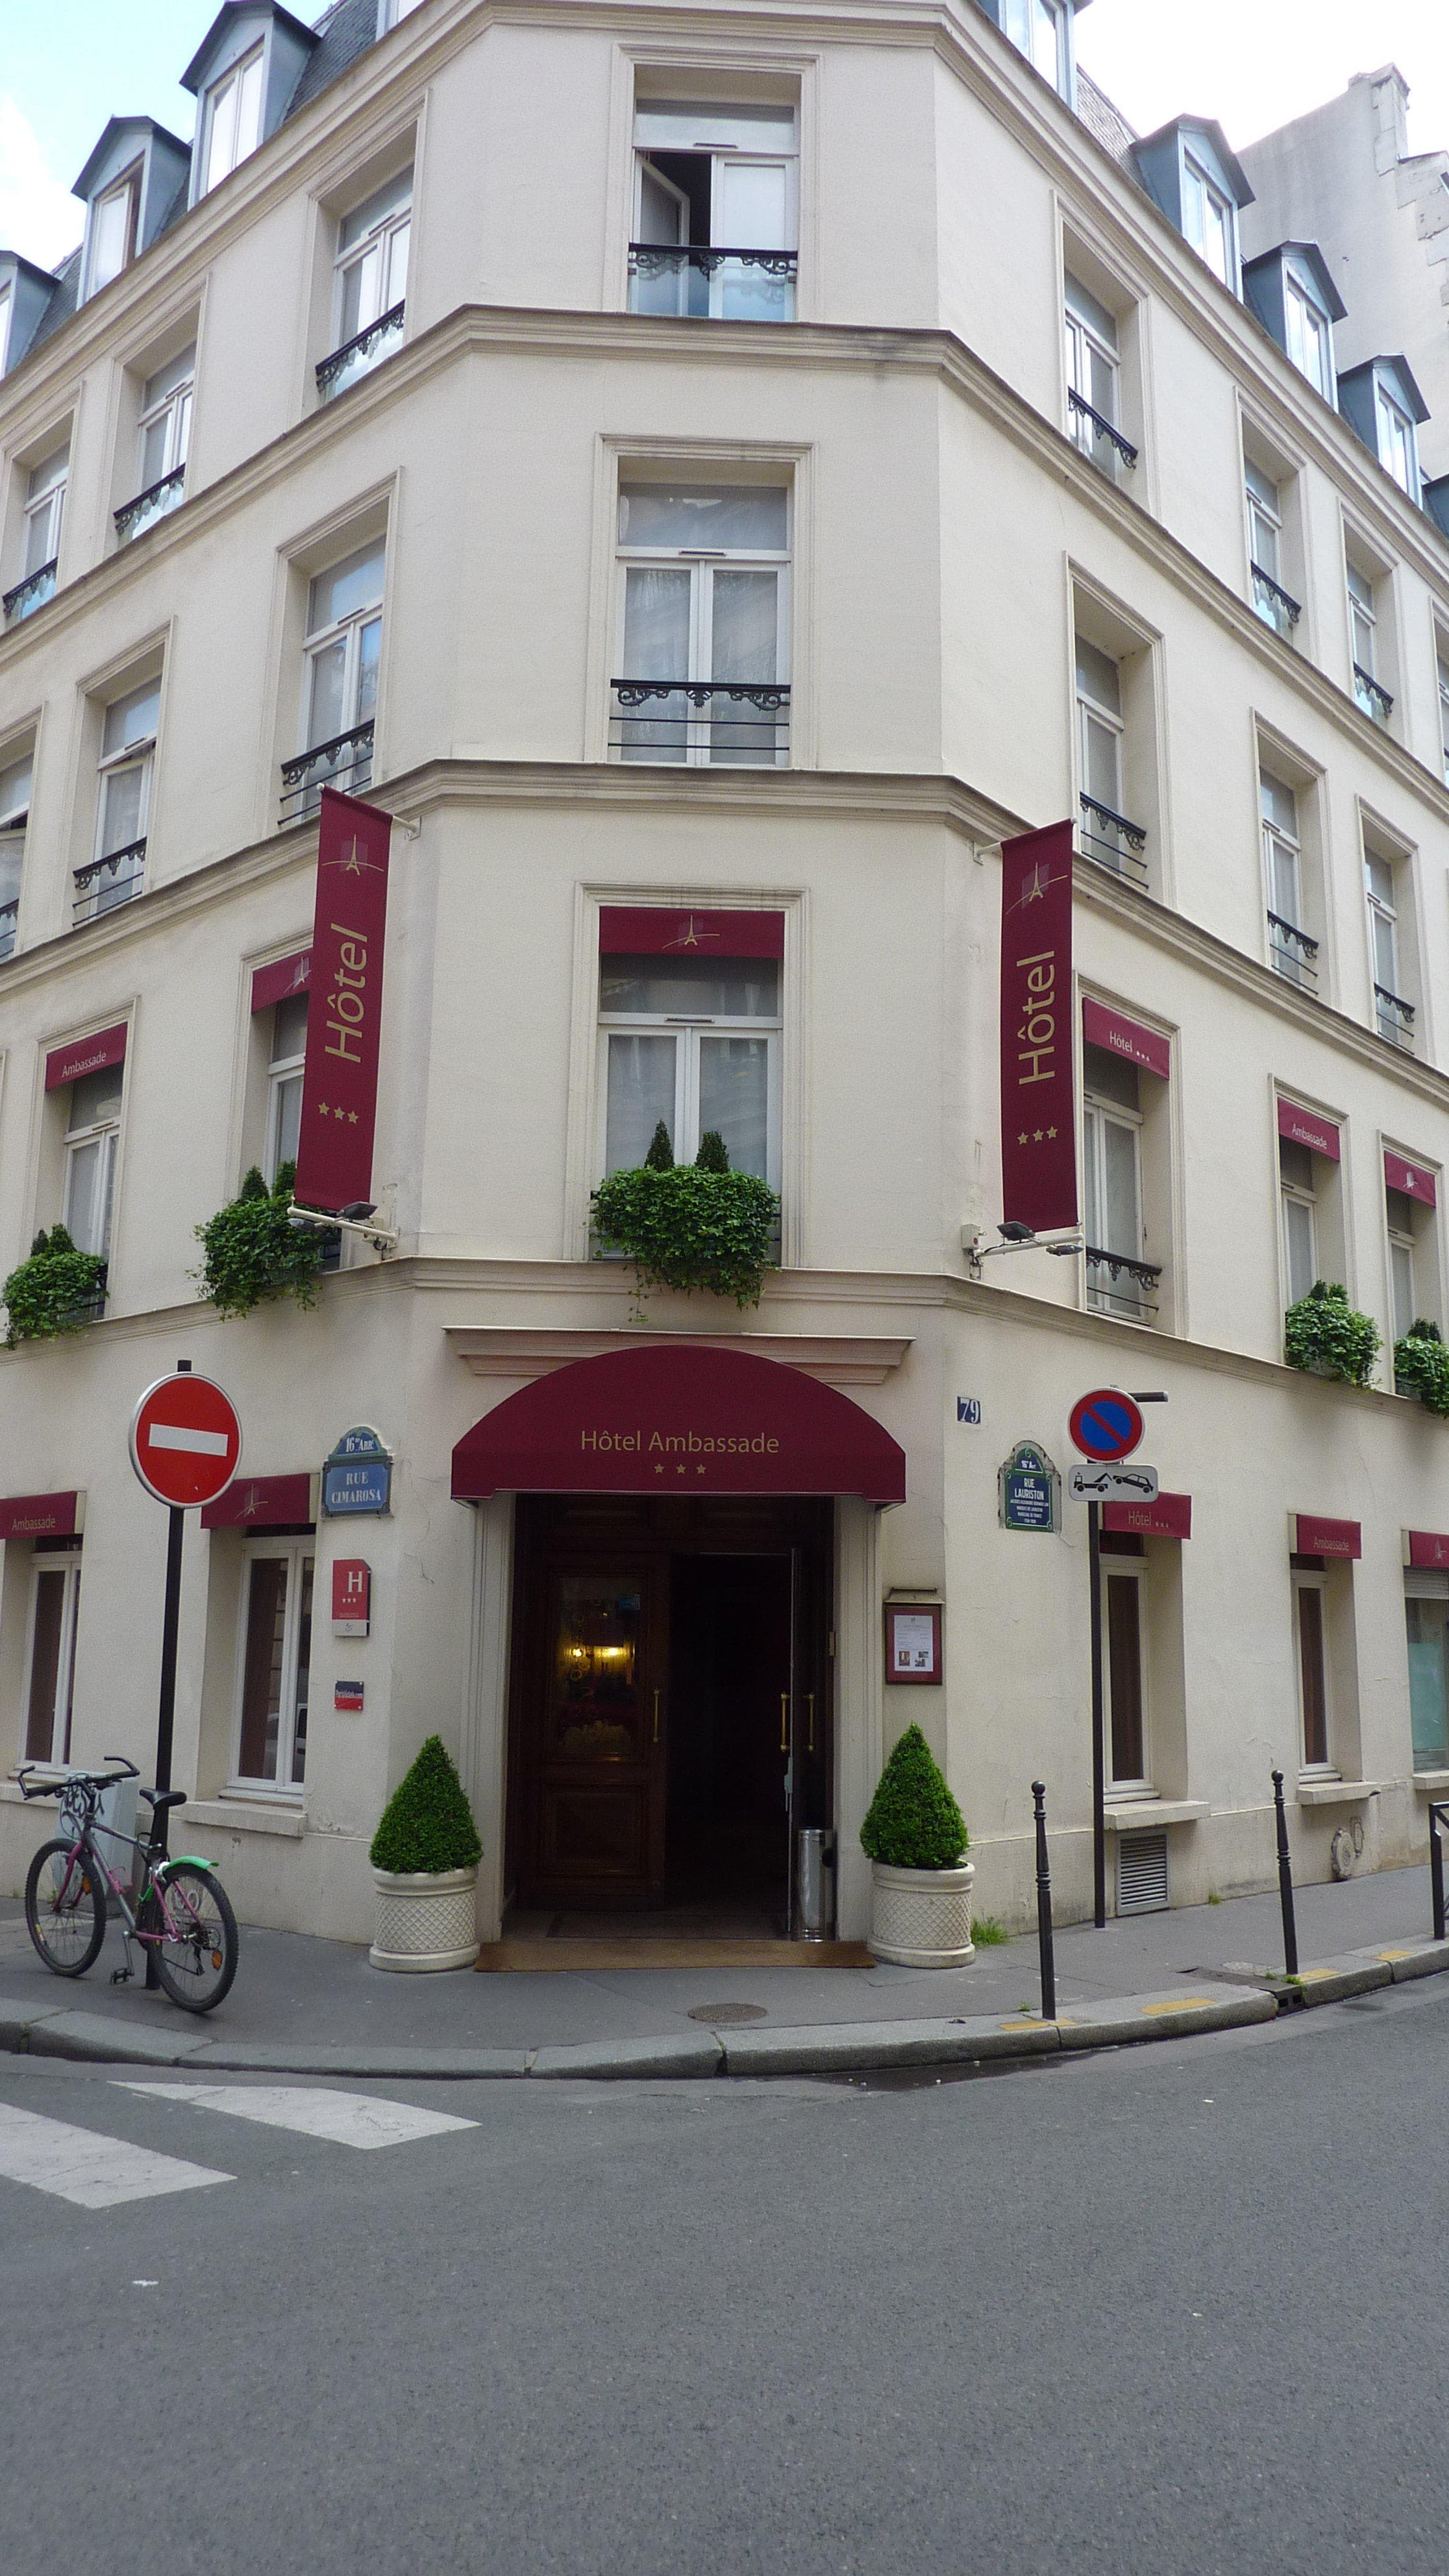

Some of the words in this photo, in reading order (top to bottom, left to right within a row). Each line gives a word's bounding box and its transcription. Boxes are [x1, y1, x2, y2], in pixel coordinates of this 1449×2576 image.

[325, 923, 367, 1063] Hôtel
[1017, 950, 1055, 1085] Hôtel
[1109, 1030, 1133, 1053] Hôtel
[62, 1050, 106, 1078] Ambassade
[1292, 1122, 1328, 1149] Ambassade
[960, 1398, 979, 1424] 79
[582, 1430, 641, 1452] Hôtel
[649, 1431, 779, 1454] Ambassade
[346, 1471, 368, 1485] RUE
[1024, 1478, 1035, 1489] RUE
[331, 1489, 381, 1504] CIMAROSA
[1015, 1488, 1044, 1500] LAURISTON
[12, 1514, 56, 1531] Ambassade
[1128, 1509, 1152, 1526] Hôtel
[1313, 1536, 1350, 1552] Ambassade
[347, 1571, 363, 1592] H
